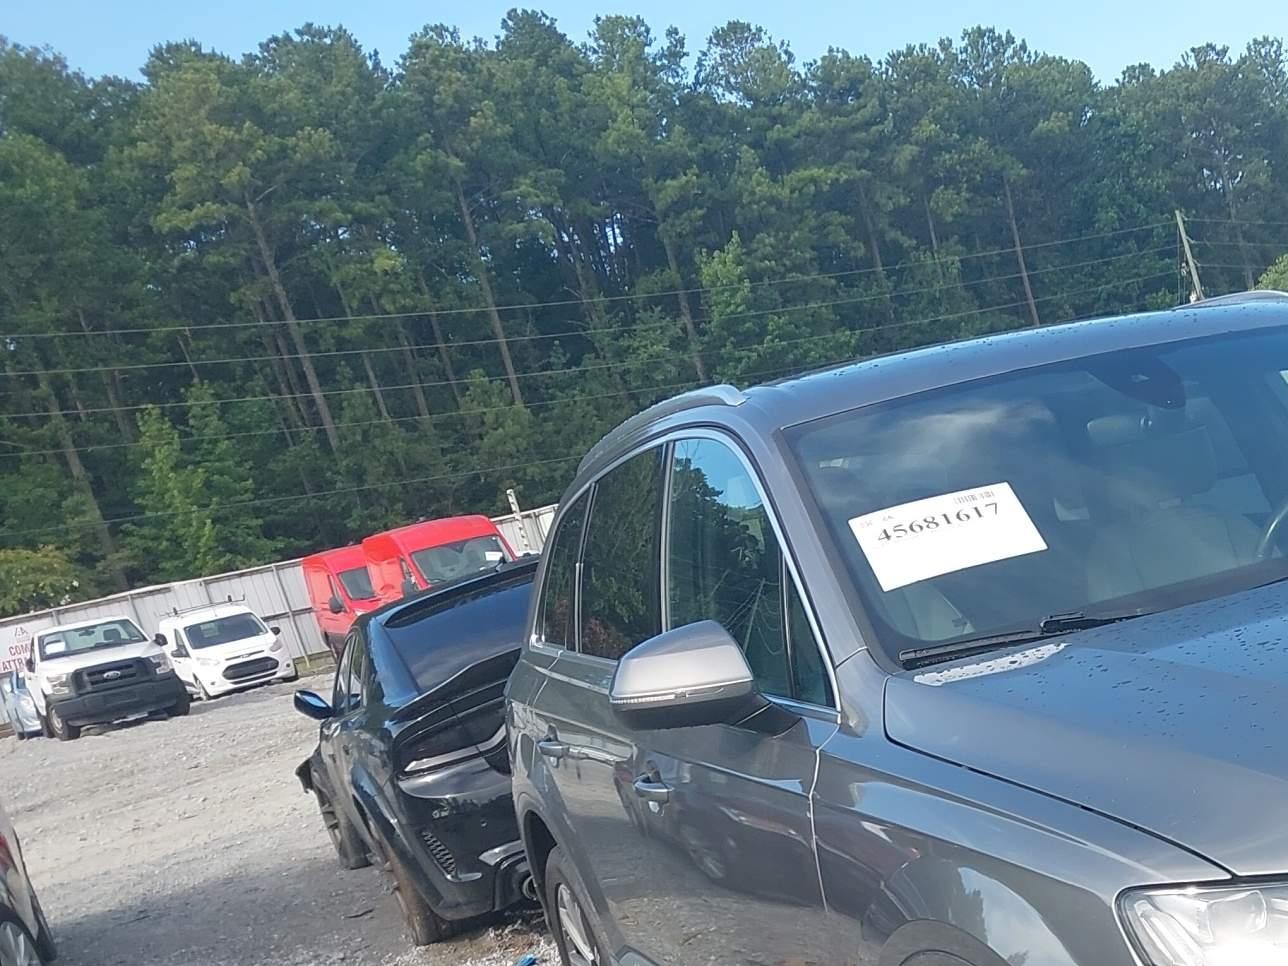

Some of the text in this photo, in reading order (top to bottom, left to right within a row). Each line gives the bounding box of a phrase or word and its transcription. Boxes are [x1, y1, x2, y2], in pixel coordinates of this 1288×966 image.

[878, 502, 998, 541] 45681617
[9, 643, 30, 656] COM
[2, 657, 26, 671] ATTR
